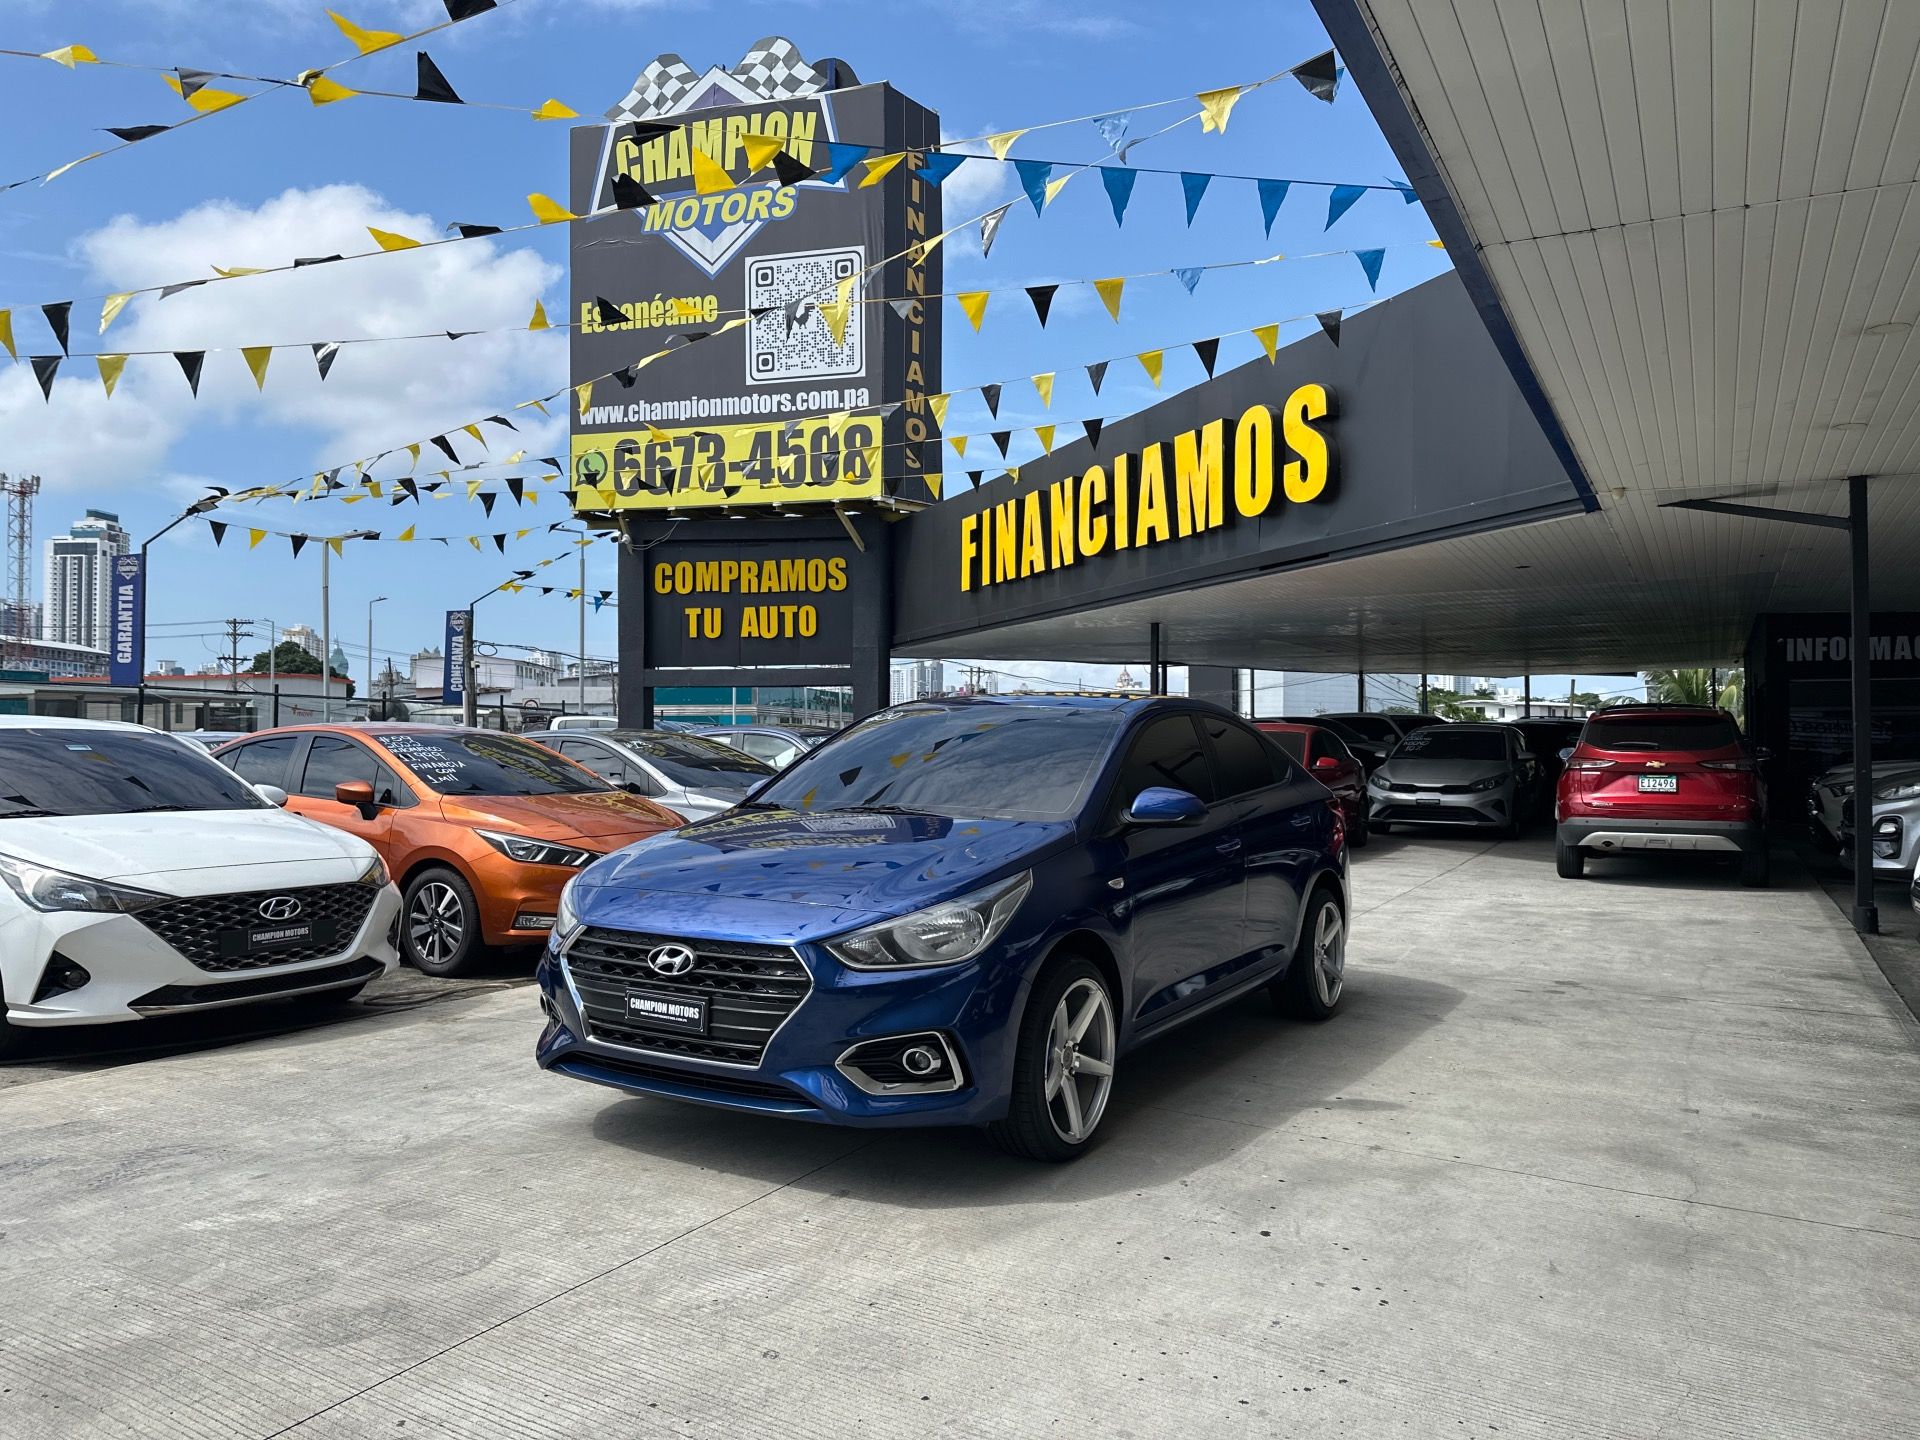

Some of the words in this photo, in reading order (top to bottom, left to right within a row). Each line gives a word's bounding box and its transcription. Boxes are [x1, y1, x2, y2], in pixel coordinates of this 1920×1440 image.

[644, 186, 796, 232] MOTORS
[578, 387, 870, 425] www.championmotors.com.pa
[613, 424, 873, 497] 6673-4508
[960, 382, 1330, 593] FINANCIAMOS
[654, 557, 848, 595] COMPRAMOS
[117, 584, 134, 664] GARANTIA
[684, 606, 723, 639] TU
[740, 605, 818, 639] AUTO
[450, 635, 464, 692] CONFIANZA
[1786, 635, 1920, 661] INFOMA
[410, 760, 467, 771] FINANCIA
[252, 930, 285, 942] CHAMPION
[284, 927, 309, 938] MOTORS
[630, 997, 668, 1014] CHAMPION
[668, 1003, 700, 1019] MOTORS
